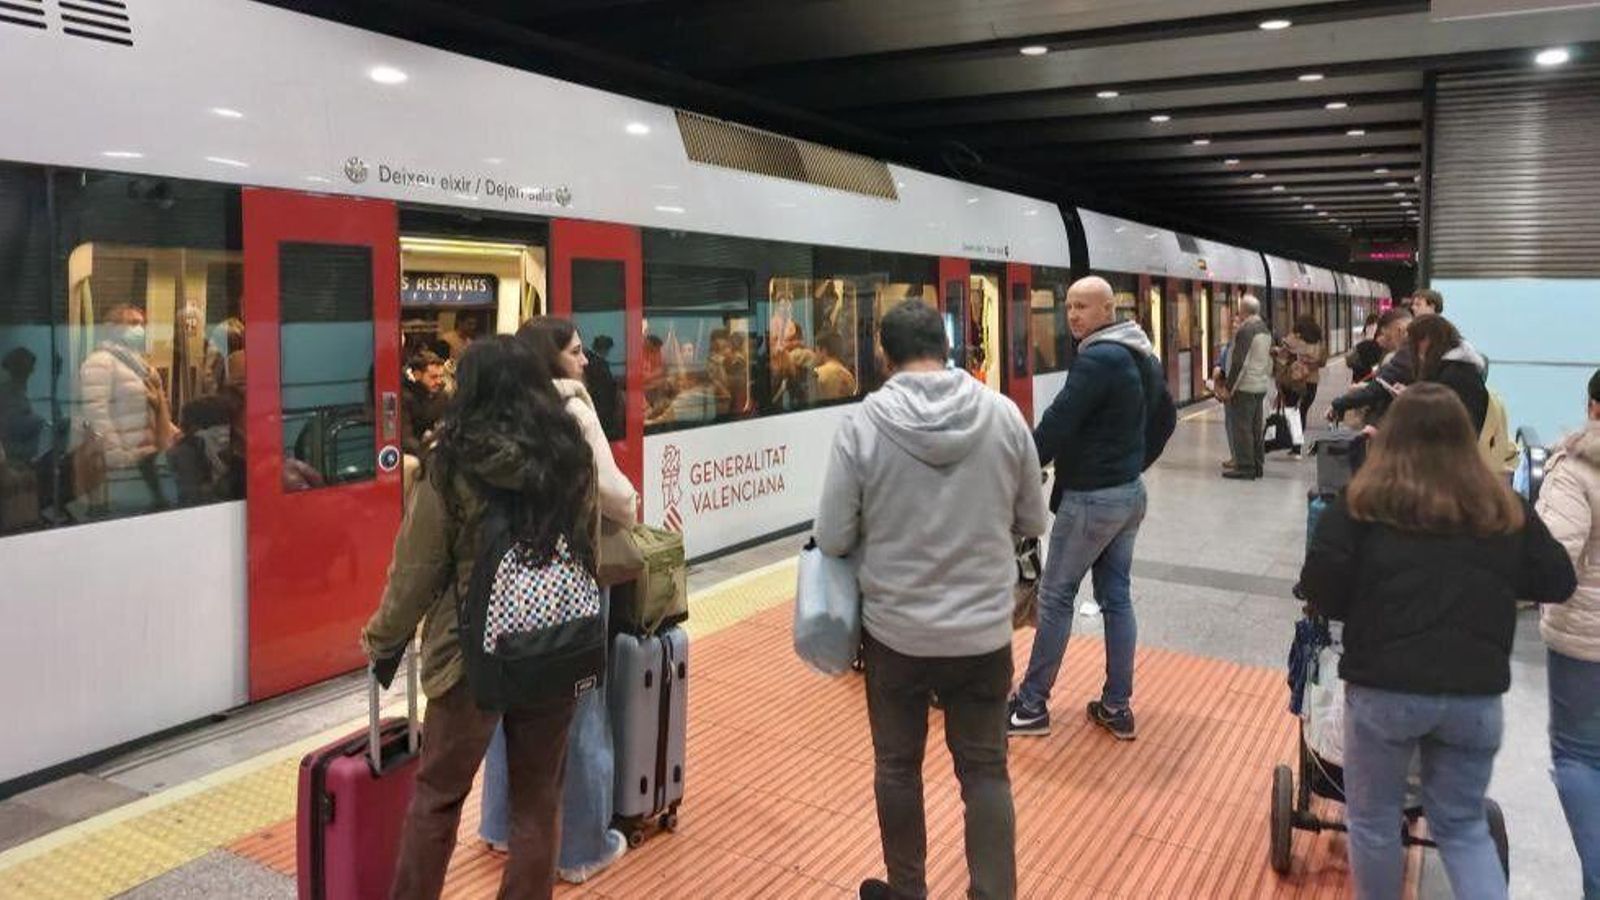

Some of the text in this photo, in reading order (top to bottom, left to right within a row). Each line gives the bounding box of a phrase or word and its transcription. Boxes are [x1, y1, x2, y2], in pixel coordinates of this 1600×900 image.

[378, 165, 436, 186] Deixeu
[440, 174, 472, 193] eixir
[416, 277, 487, 293] RESERVATS
[690, 445, 787, 486] GENERALITAT
[691, 474, 786, 515] VALENCIANA
